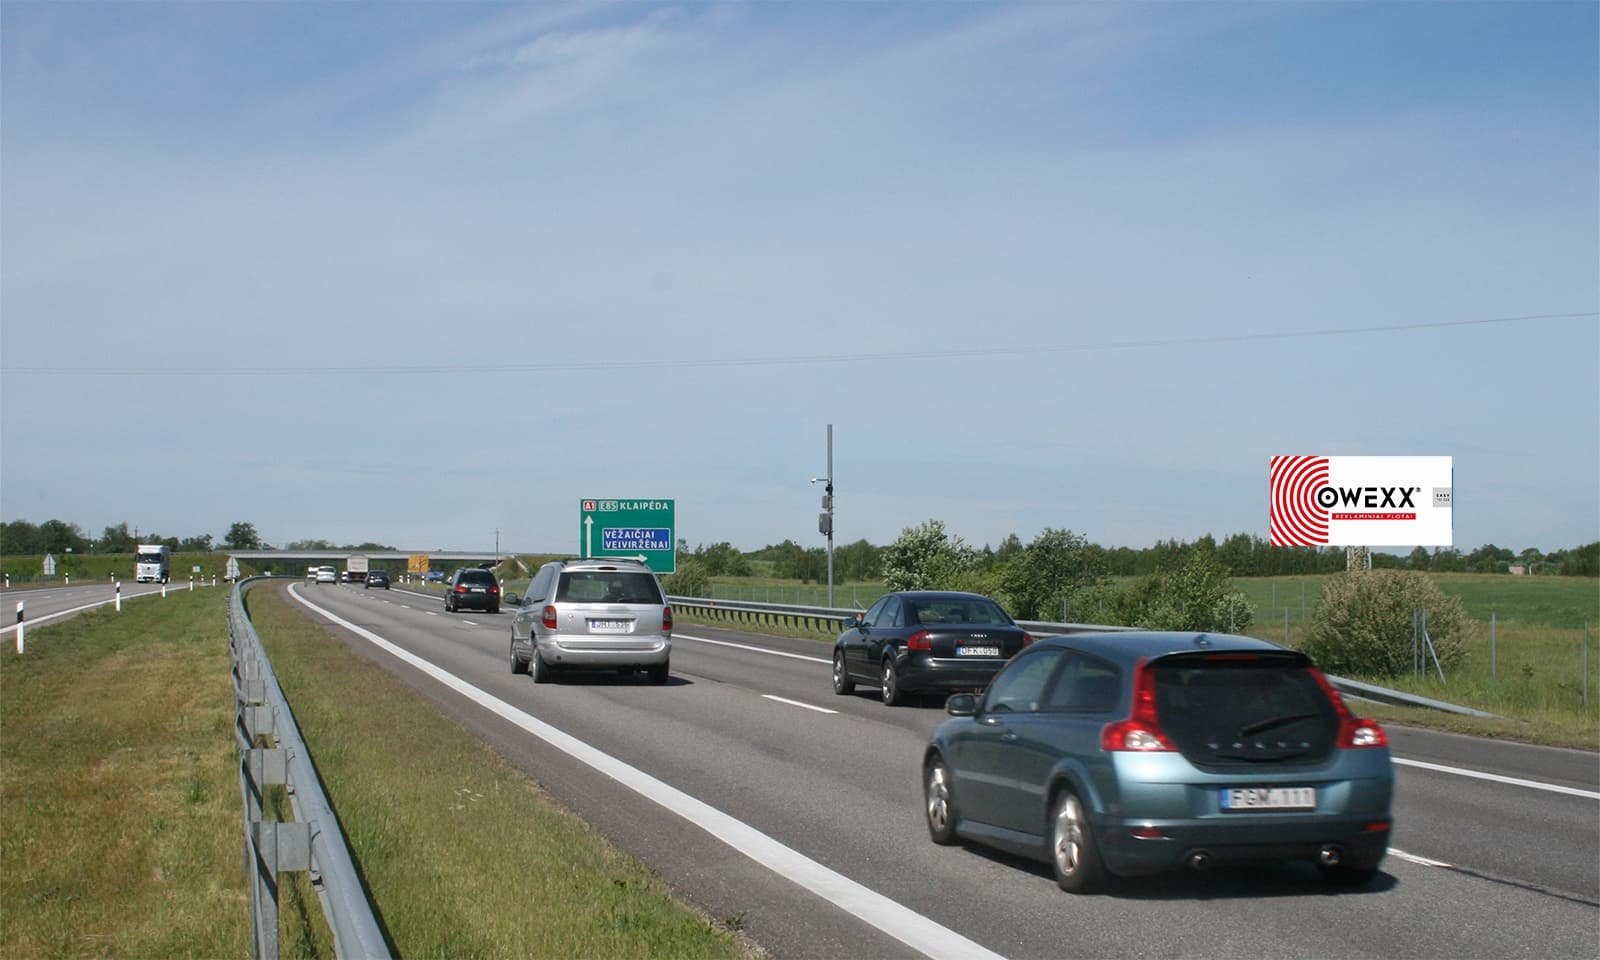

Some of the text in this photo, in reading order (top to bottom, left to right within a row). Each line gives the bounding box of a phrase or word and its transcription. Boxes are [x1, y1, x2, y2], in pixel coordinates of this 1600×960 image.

[1317, 487, 1415, 508] OWEXX
[585, 501, 669, 510] A1 E85 KLAIPĖDA
[605, 539, 668, 549] VEIVIRŽĖNAI
